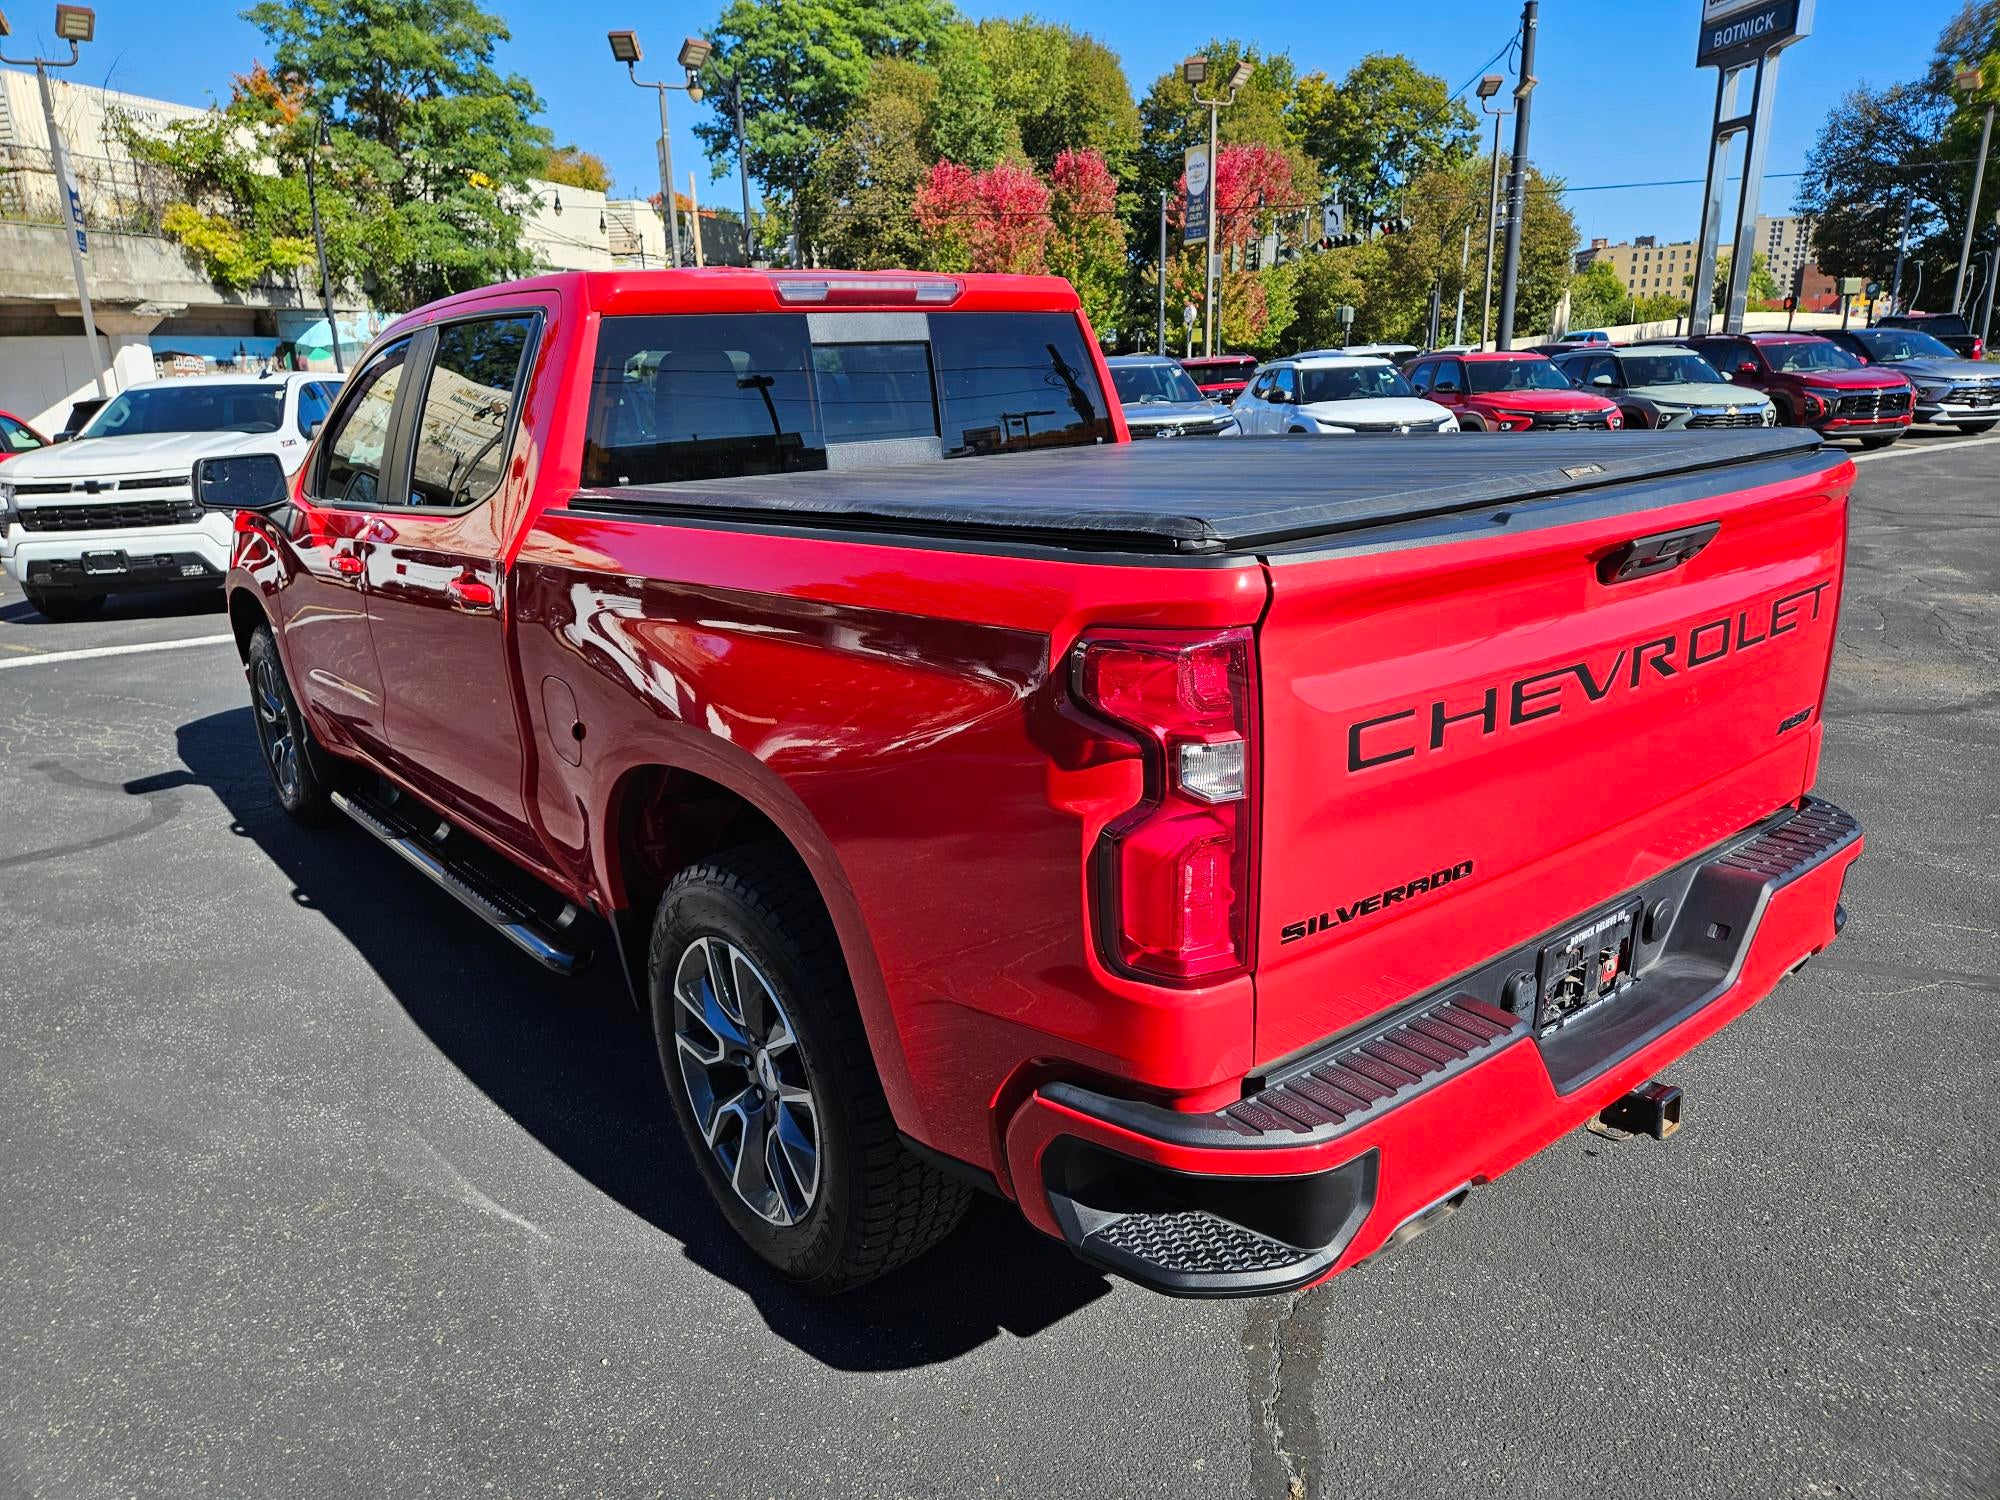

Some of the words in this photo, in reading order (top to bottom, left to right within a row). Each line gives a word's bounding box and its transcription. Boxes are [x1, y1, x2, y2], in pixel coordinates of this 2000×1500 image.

[1713, 11, 1776, 48] BOTNICK
[127, 107, 158, 123] HUNT
[1347, 581, 1830, 773] CHEVROLET
[1280, 859, 1474, 946] SILVERADO
[1570, 926, 1596, 946] BOTNICK
[1595, 915, 1618, 934] BELIEVE
